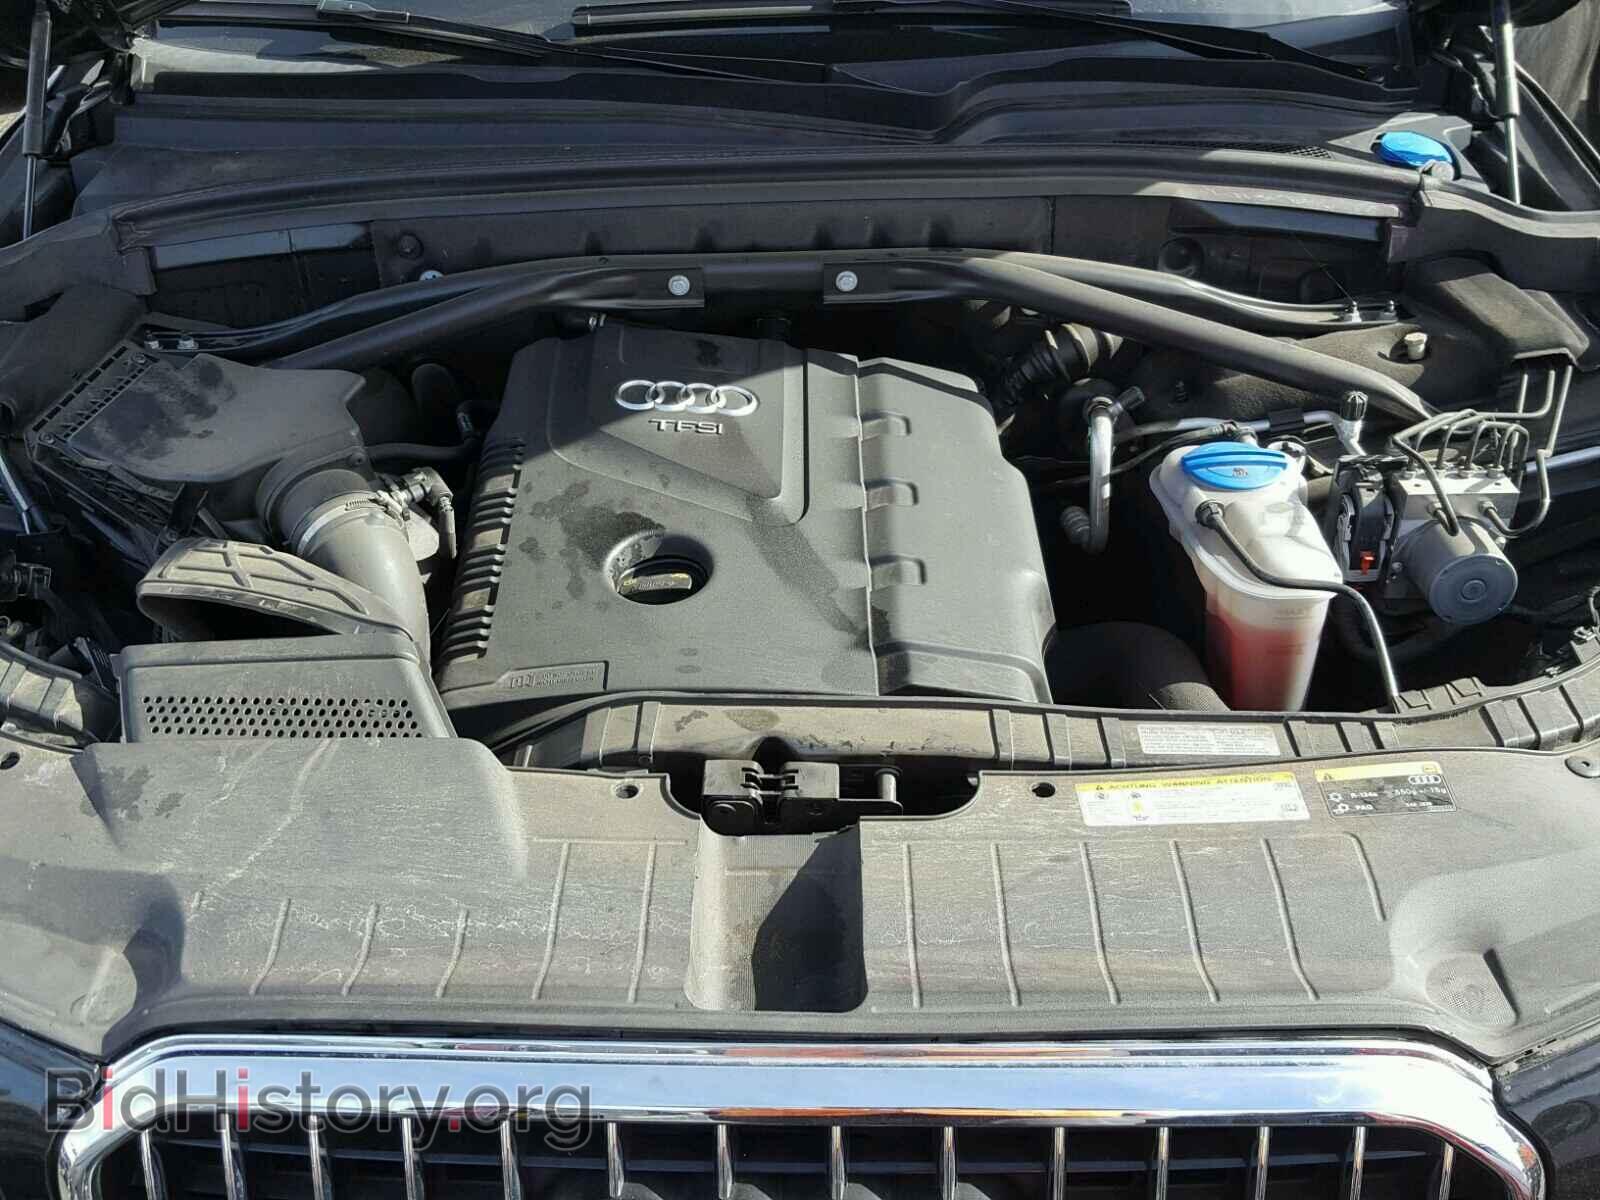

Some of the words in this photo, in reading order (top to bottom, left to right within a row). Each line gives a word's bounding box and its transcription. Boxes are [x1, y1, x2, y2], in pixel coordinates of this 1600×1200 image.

[648, 418, 723, 435] TFSI
[1162, 779, 1211, 788] WARNING
[1216, 775, 1272, 785] ATTENTION
